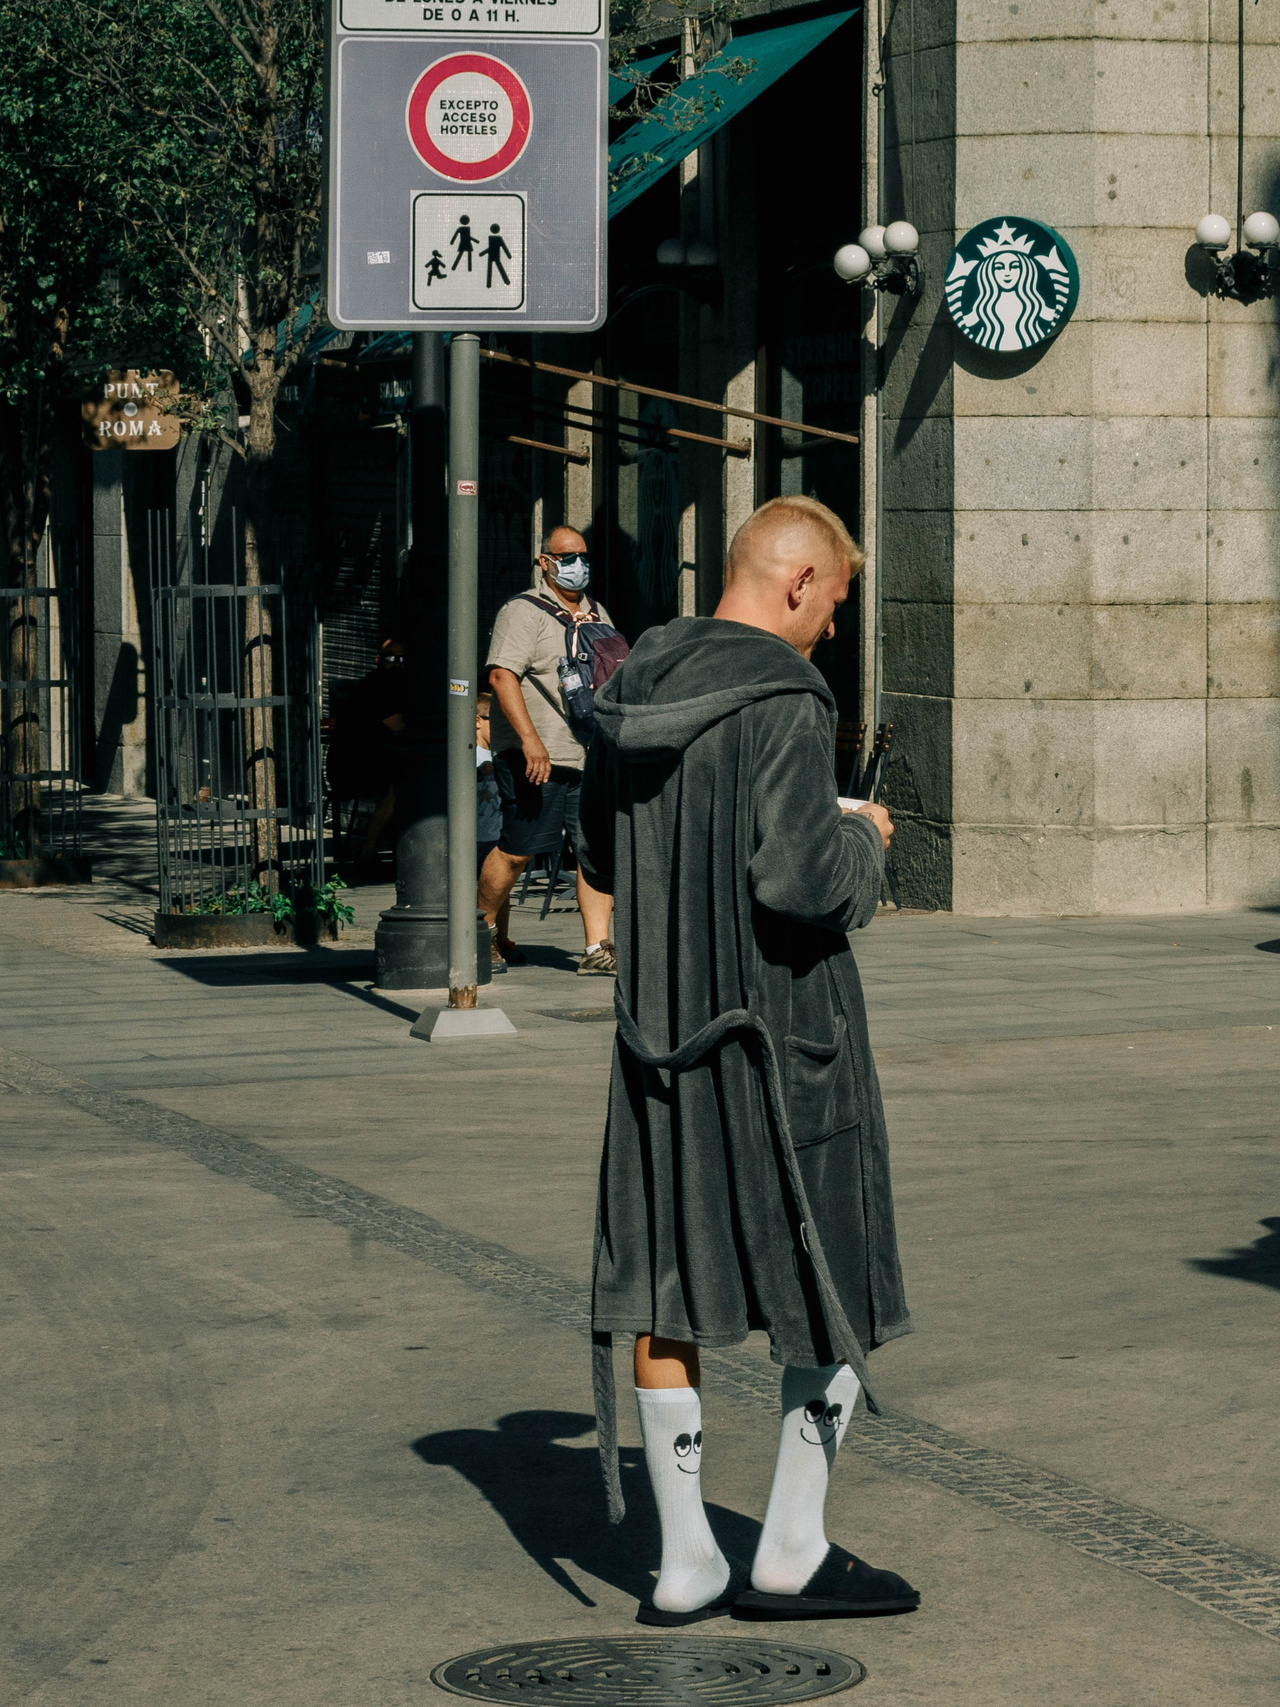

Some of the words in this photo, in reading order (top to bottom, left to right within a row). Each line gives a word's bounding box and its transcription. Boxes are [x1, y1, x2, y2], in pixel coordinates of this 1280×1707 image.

[423, 8, 444, 21] DE
[469, 9, 480, 21] A
[486, 9, 498, 22] 11
[505, 9, 519, 23] H.
[440, 100, 499, 111] EXCEPTO
[442, 112, 497, 123] ACCESO
[440, 124, 498, 136] HOTELES
[99, 420, 163, 437] ROMA
